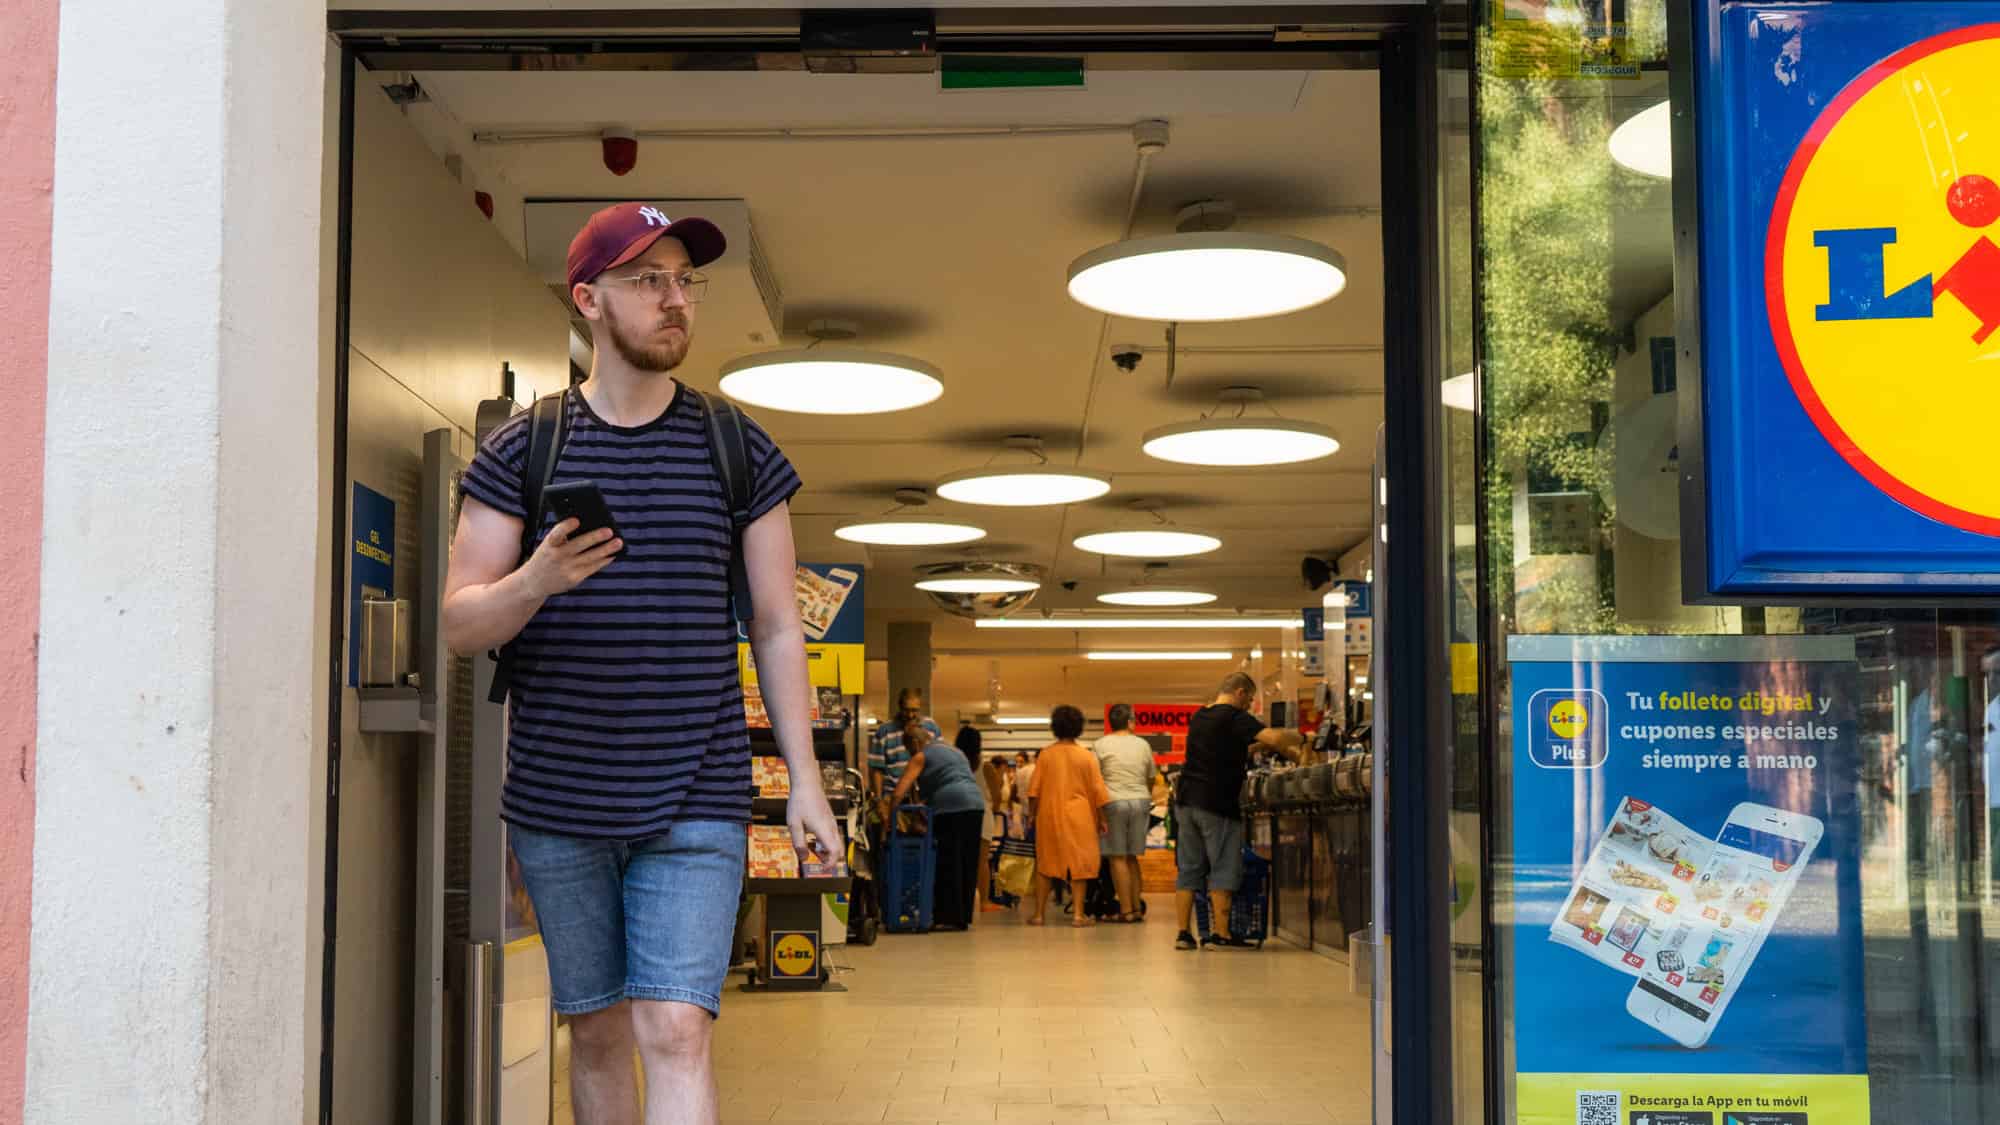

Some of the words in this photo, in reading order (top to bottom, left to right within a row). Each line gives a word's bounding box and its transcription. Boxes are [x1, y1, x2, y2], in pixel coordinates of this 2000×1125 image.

[1626, 691, 1654, 711] Tu
[1659, 691, 1733, 711] folleto
[1738, 691, 1814, 716] digital
[1818, 696, 1832, 716] y
[1620, 724, 1716, 743] cupones
[1721, 720, 1839, 744] especiales
[1551, 744, 1586, 761] Plus
[1642, 749, 1731, 773] siempre
[1737, 755, 1751, 769] a
[1757, 754, 1817, 769] mano
[1629, 1095, 1689, 1108] Descarga
[1692, 1095, 1704, 1106] la
[1707, 1095, 1734, 1109] App
[1737, 1098, 1752, 1106] en
[1756, 1096, 1769, 1106] tu
[1773, 1095, 1808, 1107] móvil
